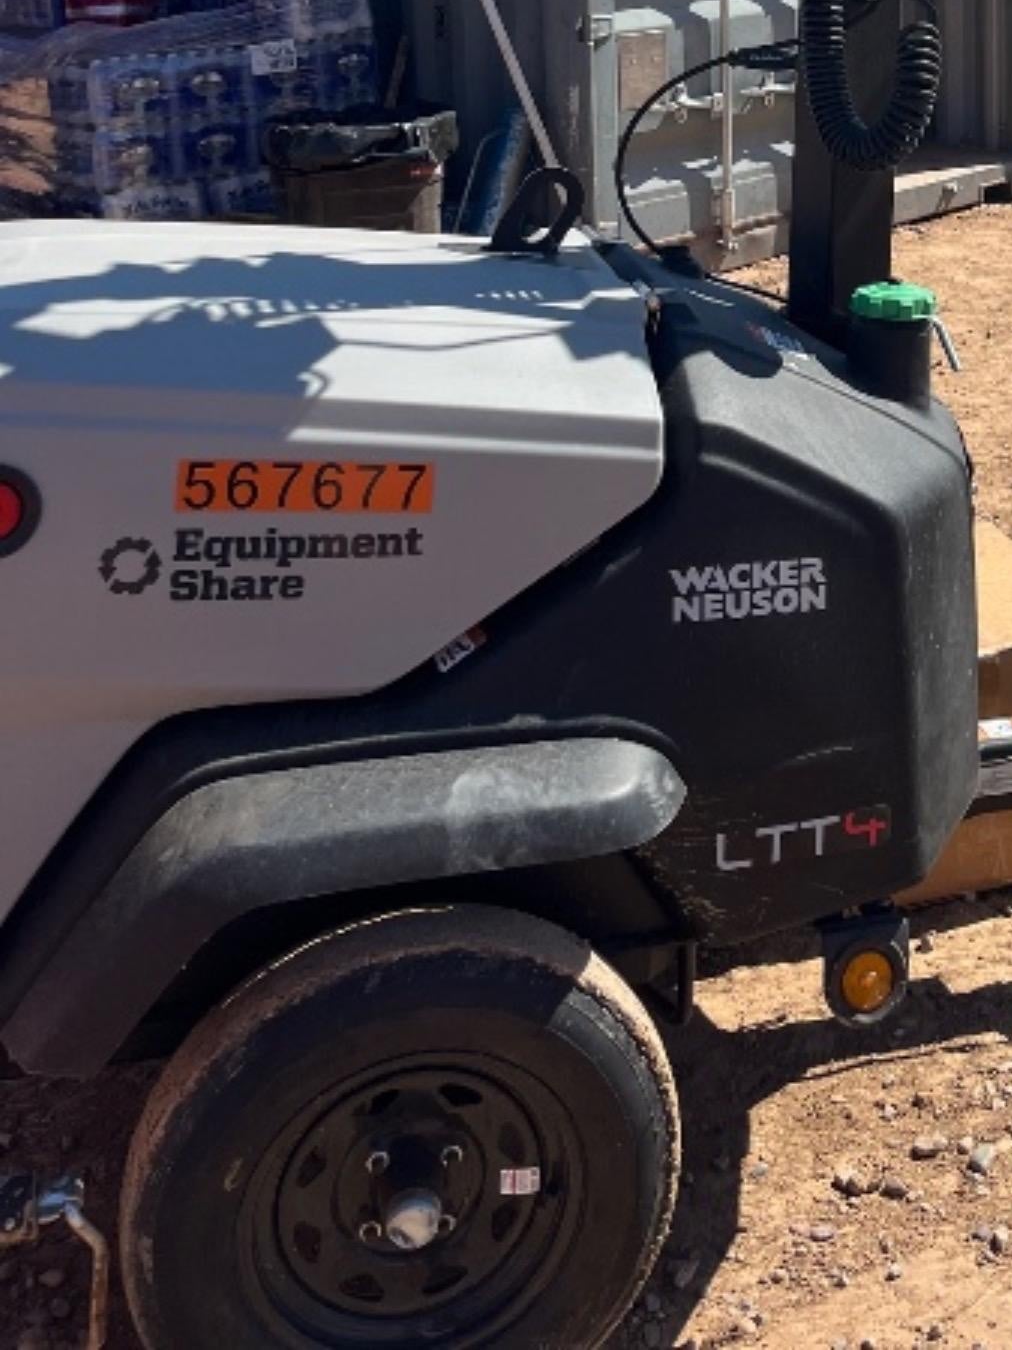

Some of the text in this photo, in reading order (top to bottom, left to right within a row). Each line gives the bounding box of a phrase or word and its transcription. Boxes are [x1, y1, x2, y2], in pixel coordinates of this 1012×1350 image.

[182, 461, 428, 511] 567677
[173, 527, 424, 567] Equipment
[169, 569, 306, 602] Share
[668, 556, 828, 595] WACKER
[672, 583, 827, 624] NEUSON
